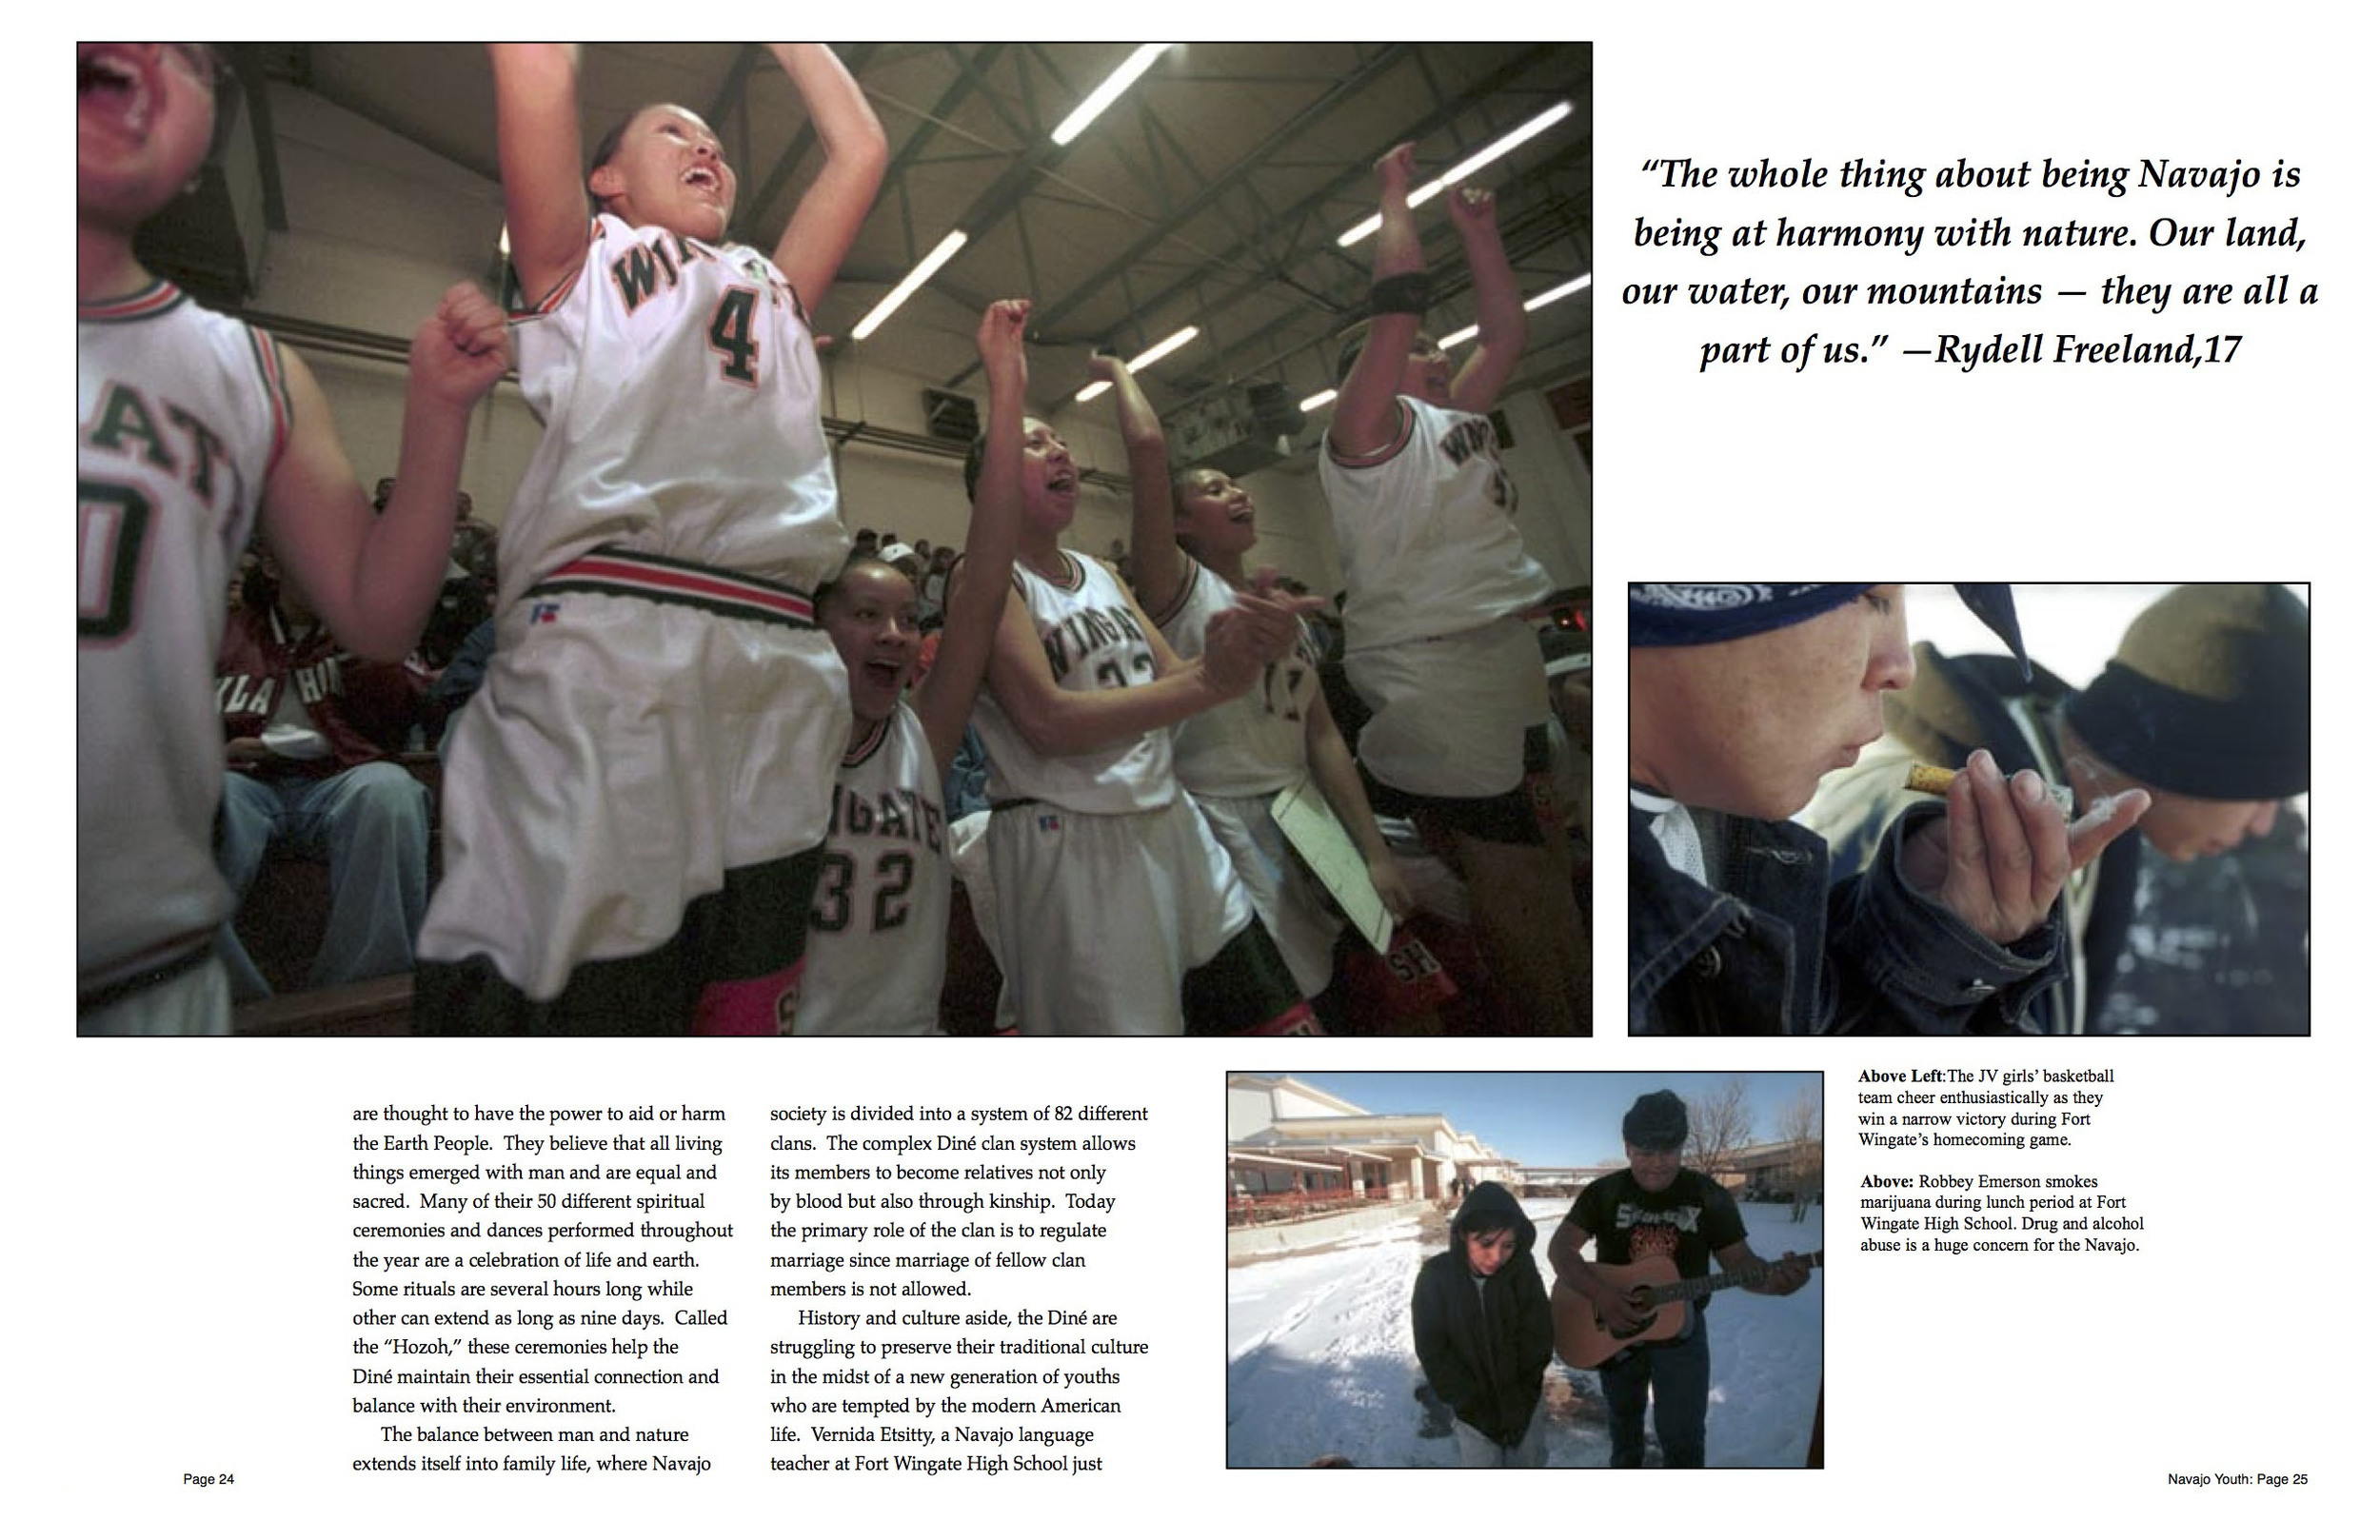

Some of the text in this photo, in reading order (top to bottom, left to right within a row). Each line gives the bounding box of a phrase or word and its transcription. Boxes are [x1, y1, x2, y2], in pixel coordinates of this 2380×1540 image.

[1641, 157, 2301, 198] “The whole thing about being Navajo is
[1635, 216, 2307, 257] being at harmony with nature. Our land,
[1622, 284, 1678, 306] our
[1687, 277, 1790, 310] water,
[1802, 284, 1859, 306] our
[1867, 275, 2042, 306] mountains
[2101, 274, 2172, 315] they
[2183, 284, 2233, 305] are
[2243, 274, 2290, 306] all
[2299, 284, 2319, 306] a
[705, 284, 762, 391] 4
[1699, 336, 1772, 373] part
[1780, 332, 1818, 373] of
[1823, 334, 1890, 364] us.”
[808, 849, 915, 932] 32
[1857, 1069, 1907, 1083] Above
[1978, 1069, 1999, 1083] JV
[2002, 1068, 2039, 1087] girls’
[2042, 1068, 2114, 1083] basketball
[1857, 1090, 2104, 1108] team cheer enthusiastically as they
[352, 1103, 726, 1127] are thought to have the power to aid or harm
[1857, 1112, 2092, 1130] win a narrow victory during Fort
[770, 1134, 1136, 1156] clans. The complex Diné clan system allows
[1858, 1132, 2072, 1150] Wingate’s homecoming game.
[1860, 1174, 2098, 1192] Above: Robbey Emerson smokes
[1860, 1194, 2127, 1213] marijuana during lunch period at Fort
[352, 1220, 734, 1243] ceremonies and dances performed throughout
[1860, 1215, 2145, 1234] Wingate High School. Drug and alcohol
[1860, 1237, 2140, 1255] abuse is a huge concern for the Navajo.
[770, 1280, 972, 1296] members is not allowed.
[352, 1308, 728, 1331] other can extend as long as nine days. Called
[770, 1337, 1149, 1360] struggling to preserve their traditional culture
[351, 1395, 616, 1413] balance with their environment.
[770, 1395, 1121, 1418] who are tempted by the modern American
[352, 1453, 711, 1476] extends itself into family life, where Navajo
[184, 1472, 235, 1488] Page 24
[2168, 1472, 2309, 1488] Navajo Youth: Page 25
